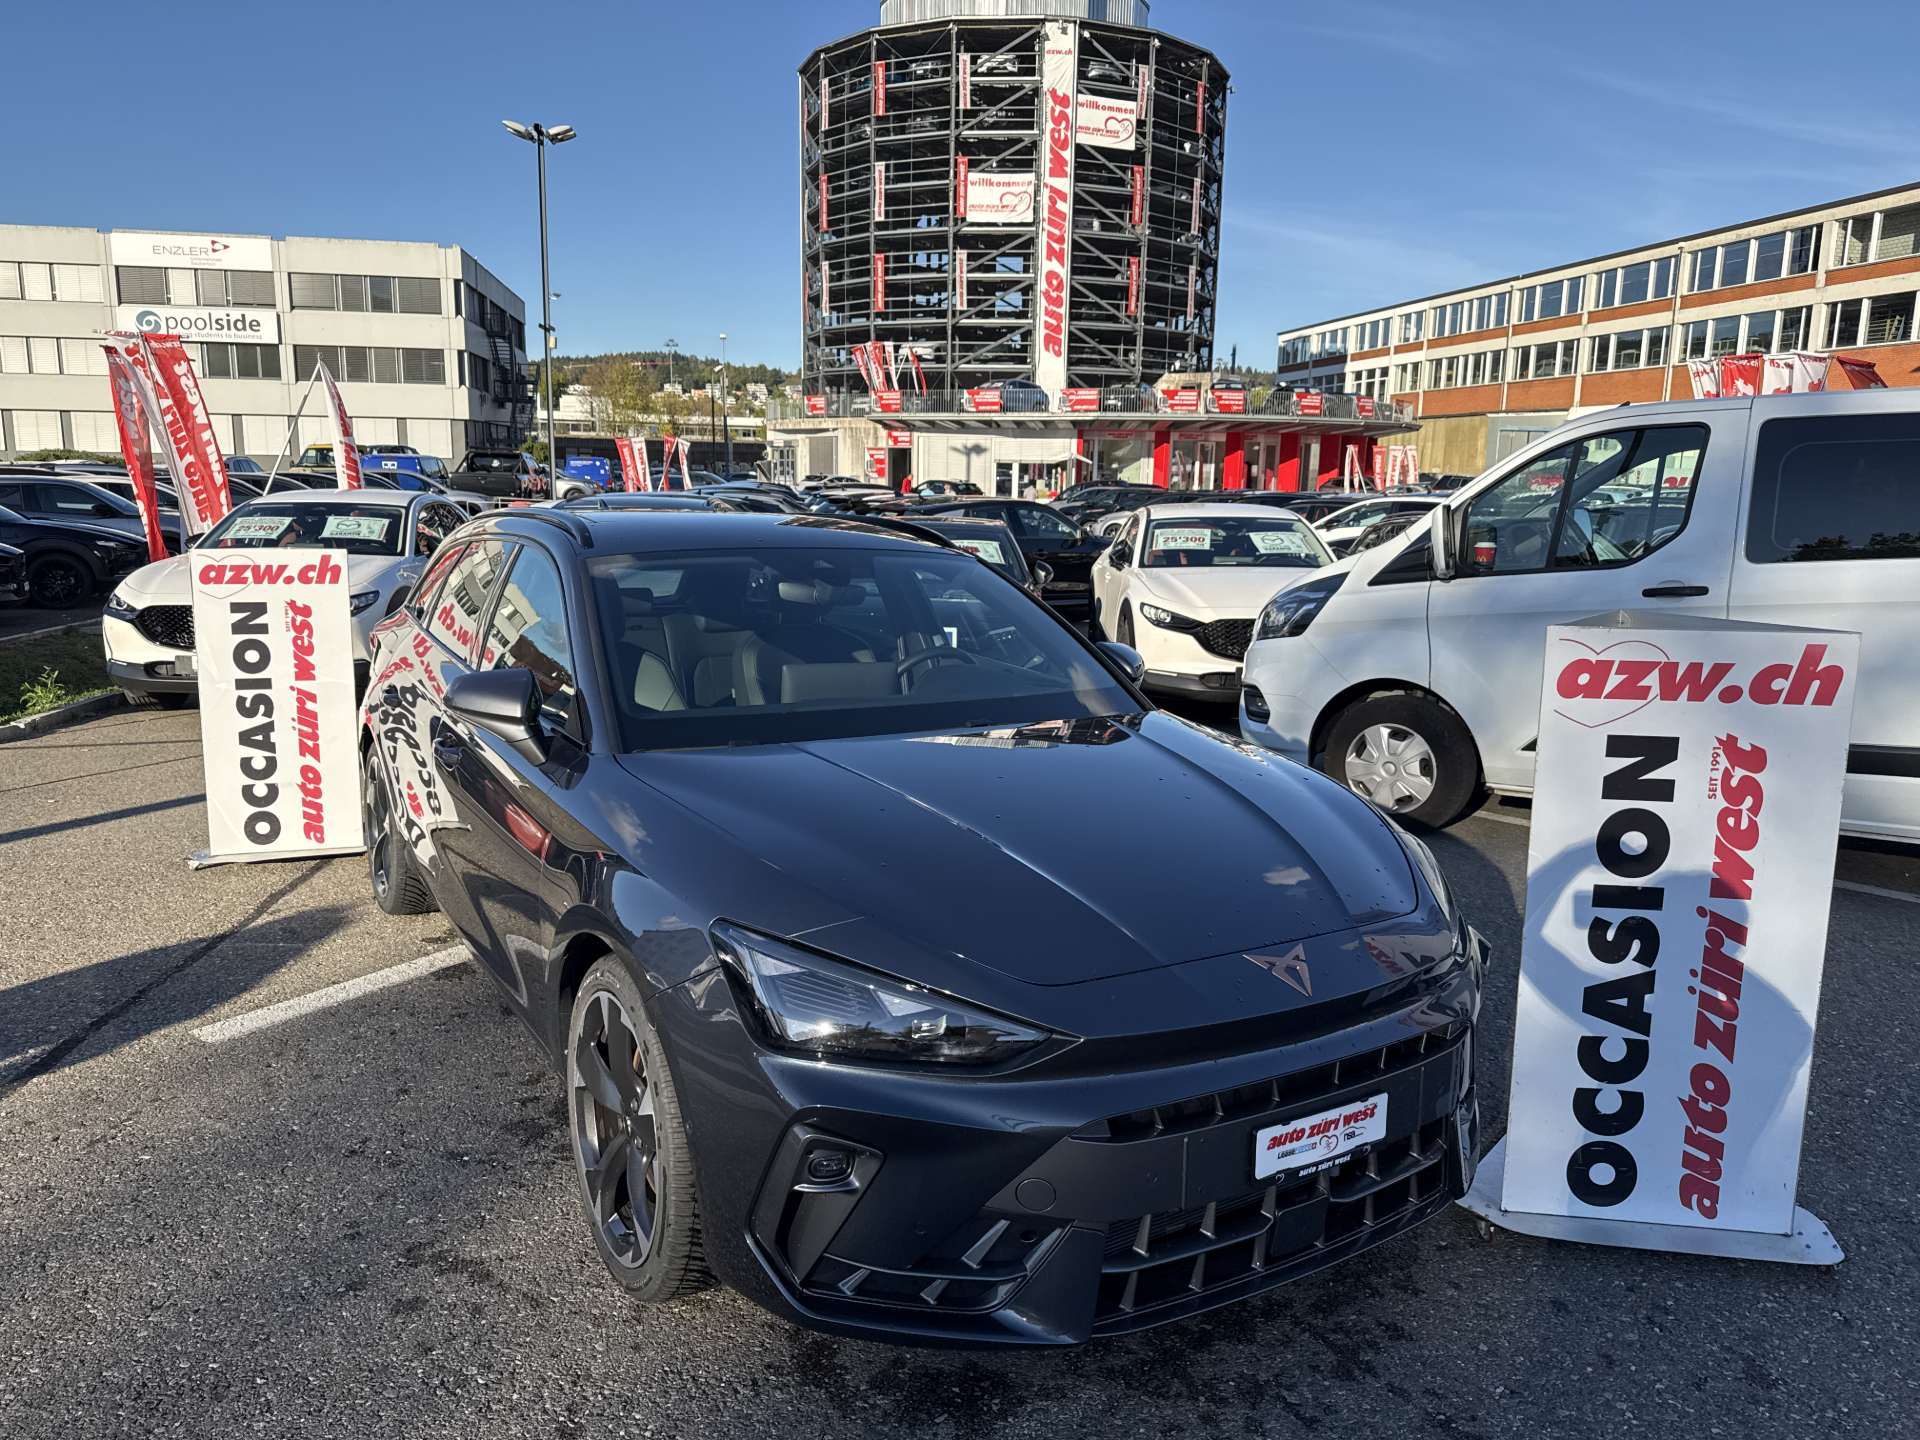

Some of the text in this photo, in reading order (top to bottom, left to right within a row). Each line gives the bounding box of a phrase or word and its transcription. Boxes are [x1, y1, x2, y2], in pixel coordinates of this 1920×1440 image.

[1077, 99, 1135, 115] willkommen
[1041, 87, 1071, 357] auto züri west
[152, 245, 210, 256] ENZLER
[165, 312, 262, 335] poolside
[199, 554, 342, 585] azw.ch
[1555, 643, 1845, 707] azw.ch
[229, 601, 282, 846] OCCASION
[284, 599, 326, 845] auto züri west
[1707, 745, 1722, 800] SEIT 1991
[1566, 733, 1680, 1208] OCCASION
[1677, 732, 1768, 1221] auto züri west
[1267, 1126, 1306, 1151] auto
[1306, 1113, 1341, 1139] züri
[1342, 1102, 1378, 1127] west
[1298, 1166, 1317, 1177] auto
[1334, 1153, 1352, 1165] west
